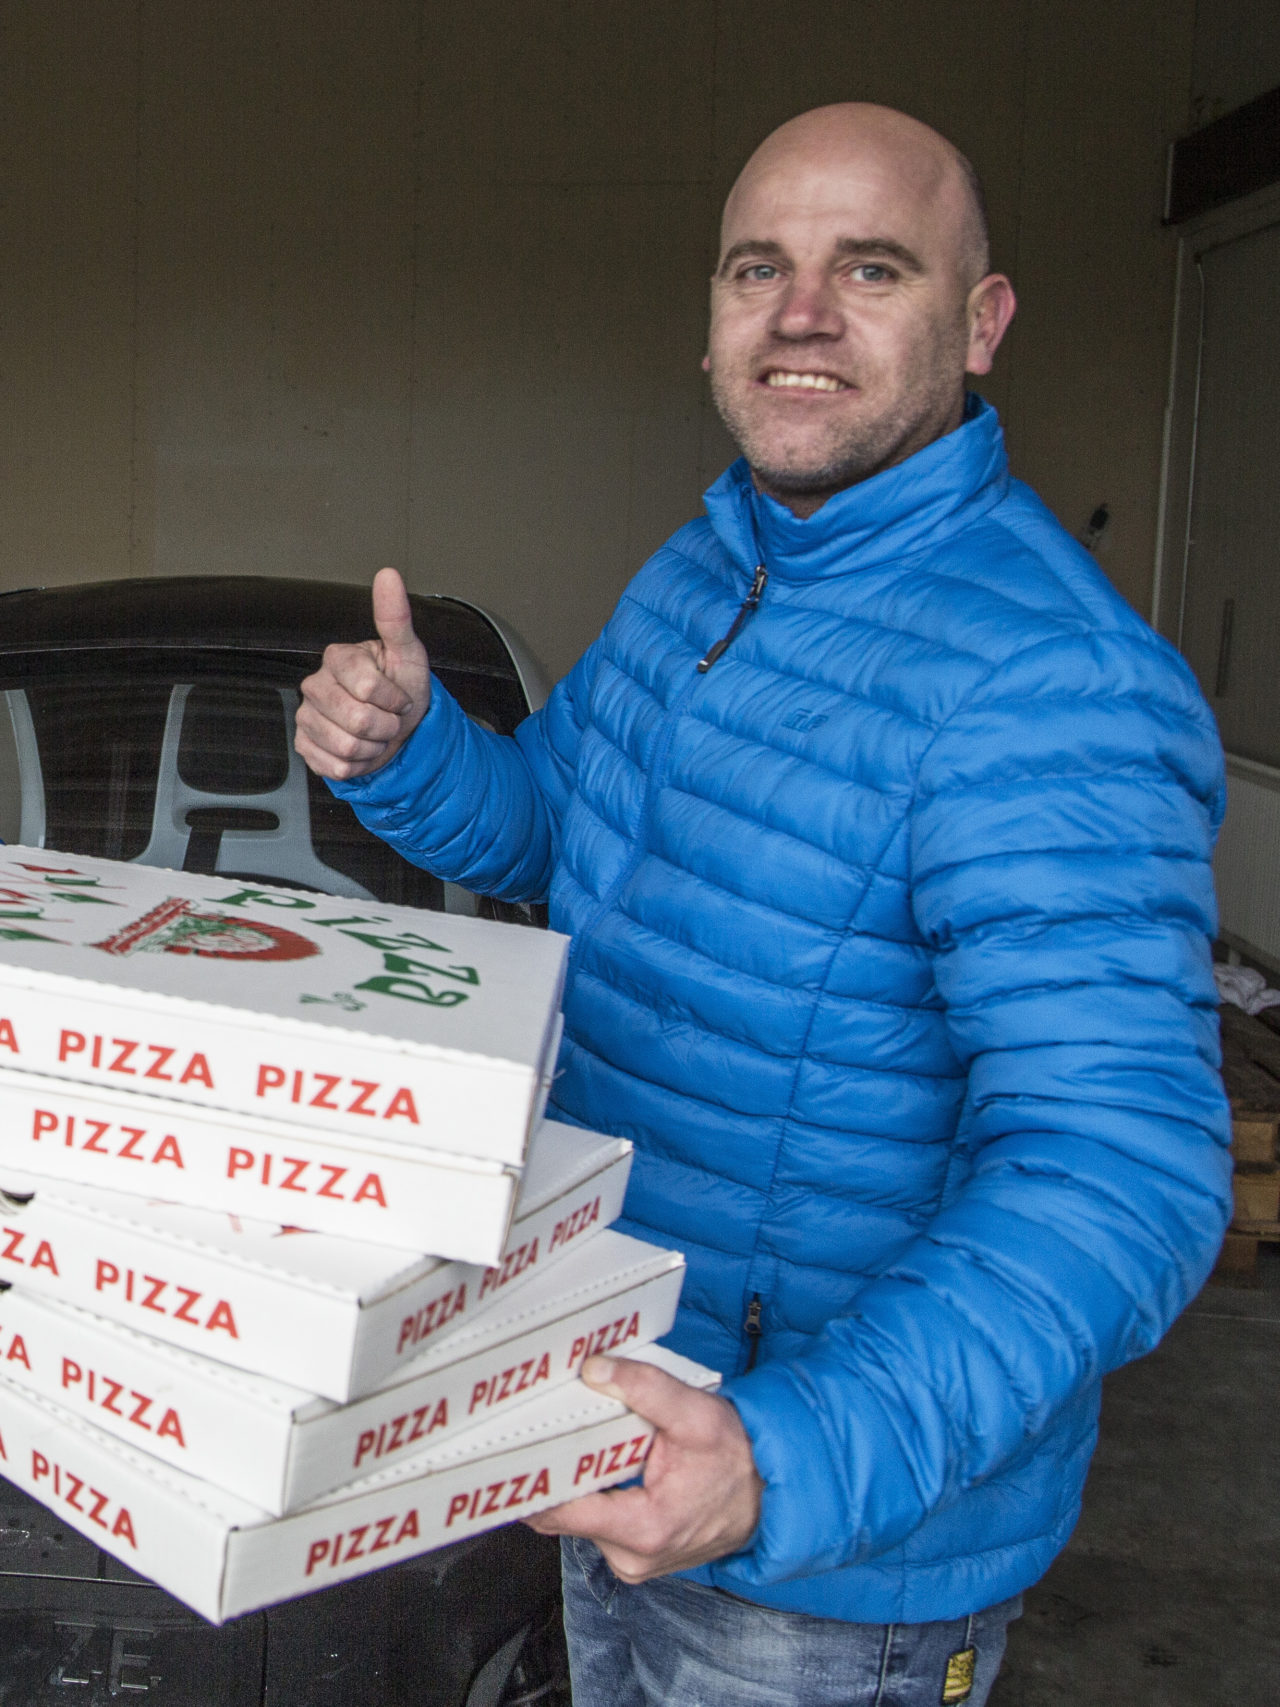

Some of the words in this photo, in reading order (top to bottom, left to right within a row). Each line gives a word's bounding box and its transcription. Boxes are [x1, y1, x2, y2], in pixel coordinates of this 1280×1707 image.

[58, 1029, 214, 1088] PIZZA
[256, 1064, 419, 1125] PIZZA
[33, 1110, 184, 1168] PIZZA
[227, 1147, 387, 1208] PIZZA
[96, 1260, 238, 1339] PIZZA
[396, 1283, 466, 1355] PIZZA
[477, 1237, 539, 1300] PIZZA
[548, 1196, 601, 1253] PIZZA
[62, 1358, 185, 1447] PIZZA
[353, 1398, 449, 1467] PIZZA
[468, 1353, 550, 1415] PIZZA
[568, 1311, 640, 1370] PIZZA
[32, 1451, 136, 1548] PIZZA
[306, 1511, 419, 1575] PIZZA
[446, 1469, 550, 1526] PIZZA
[573, 1434, 652, 1486] PIZZ
